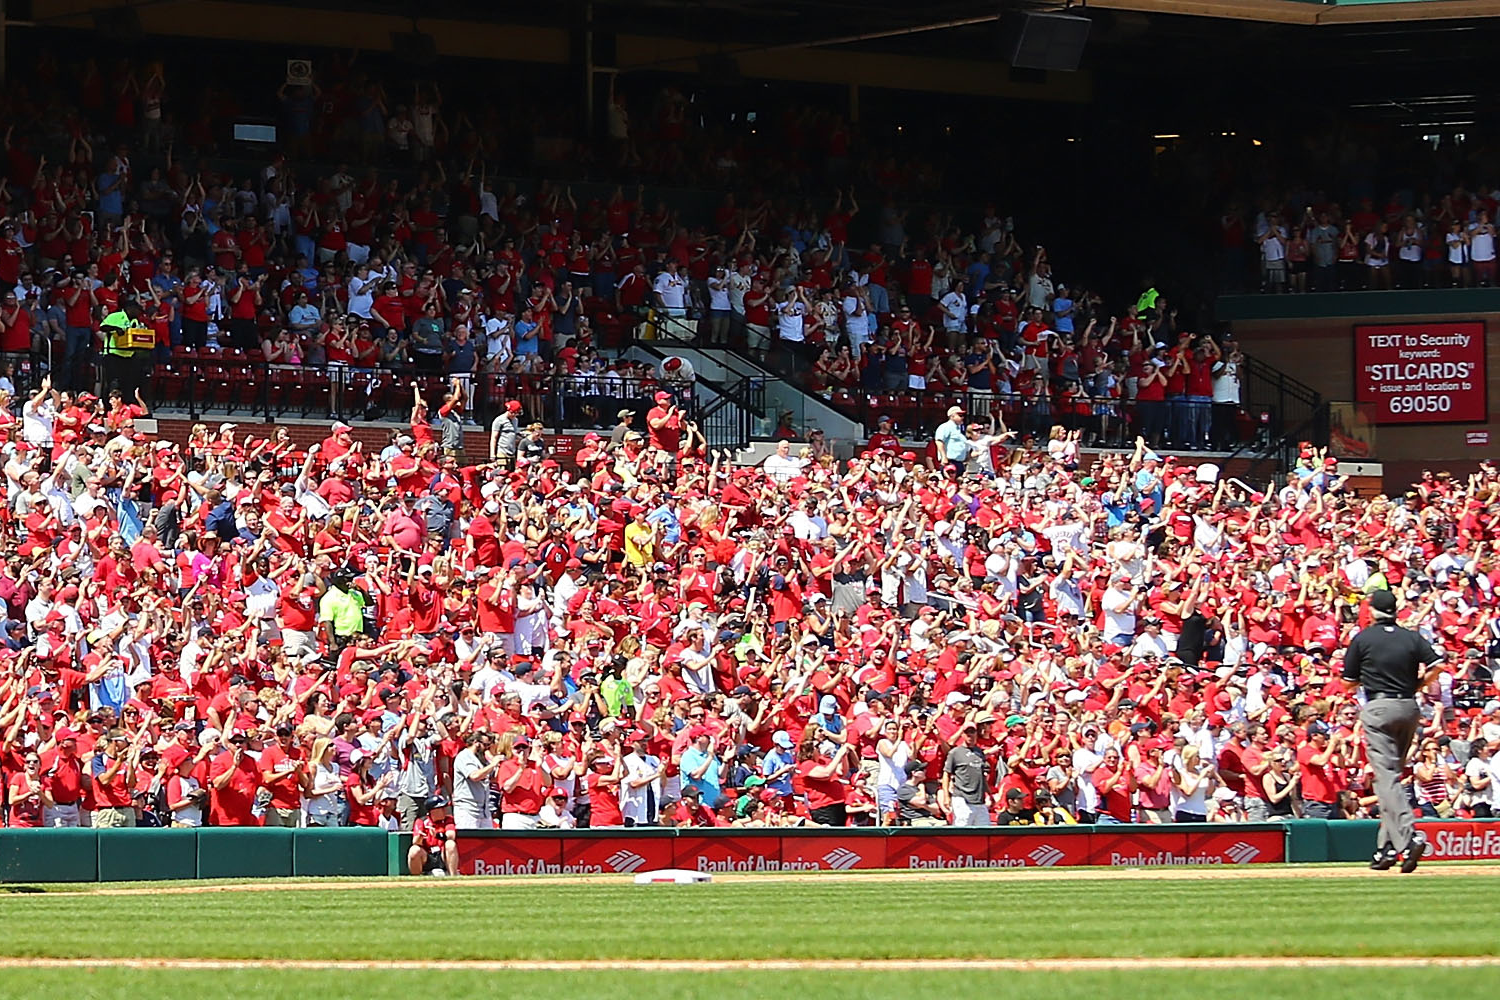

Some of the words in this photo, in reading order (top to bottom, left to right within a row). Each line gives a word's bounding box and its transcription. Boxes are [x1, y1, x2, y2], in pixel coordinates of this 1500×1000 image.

[1368, 334, 1402, 348] TEXT
[1405, 335, 1417, 347] to
[1419, 332, 1471, 348] Security
[1399, 349, 1441, 360] keyword:
[1380, 383, 1403, 392] issue
[1405, 382, 1422, 391] and
[1425, 381, 1459, 391] location
[1461, 381, 1472, 390] to
[1389, 395, 1451, 413] 69050
[697, 856, 736, 872] Bank
[737, 855, 754, 872] of
[755, 856, 820, 871] America
[909, 855, 946, 869] Bank
[947, 855, 963, 869] of
[964, 854, 1026, 868] America
[1111, 853, 1147, 866] Bank
[1148, 852, 1164, 865] of
[1164, 852, 1222, 865] America
[474, 859, 514, 875] Bank
[516, 859, 534, 874] of
[535, 859, 602, 874] America
